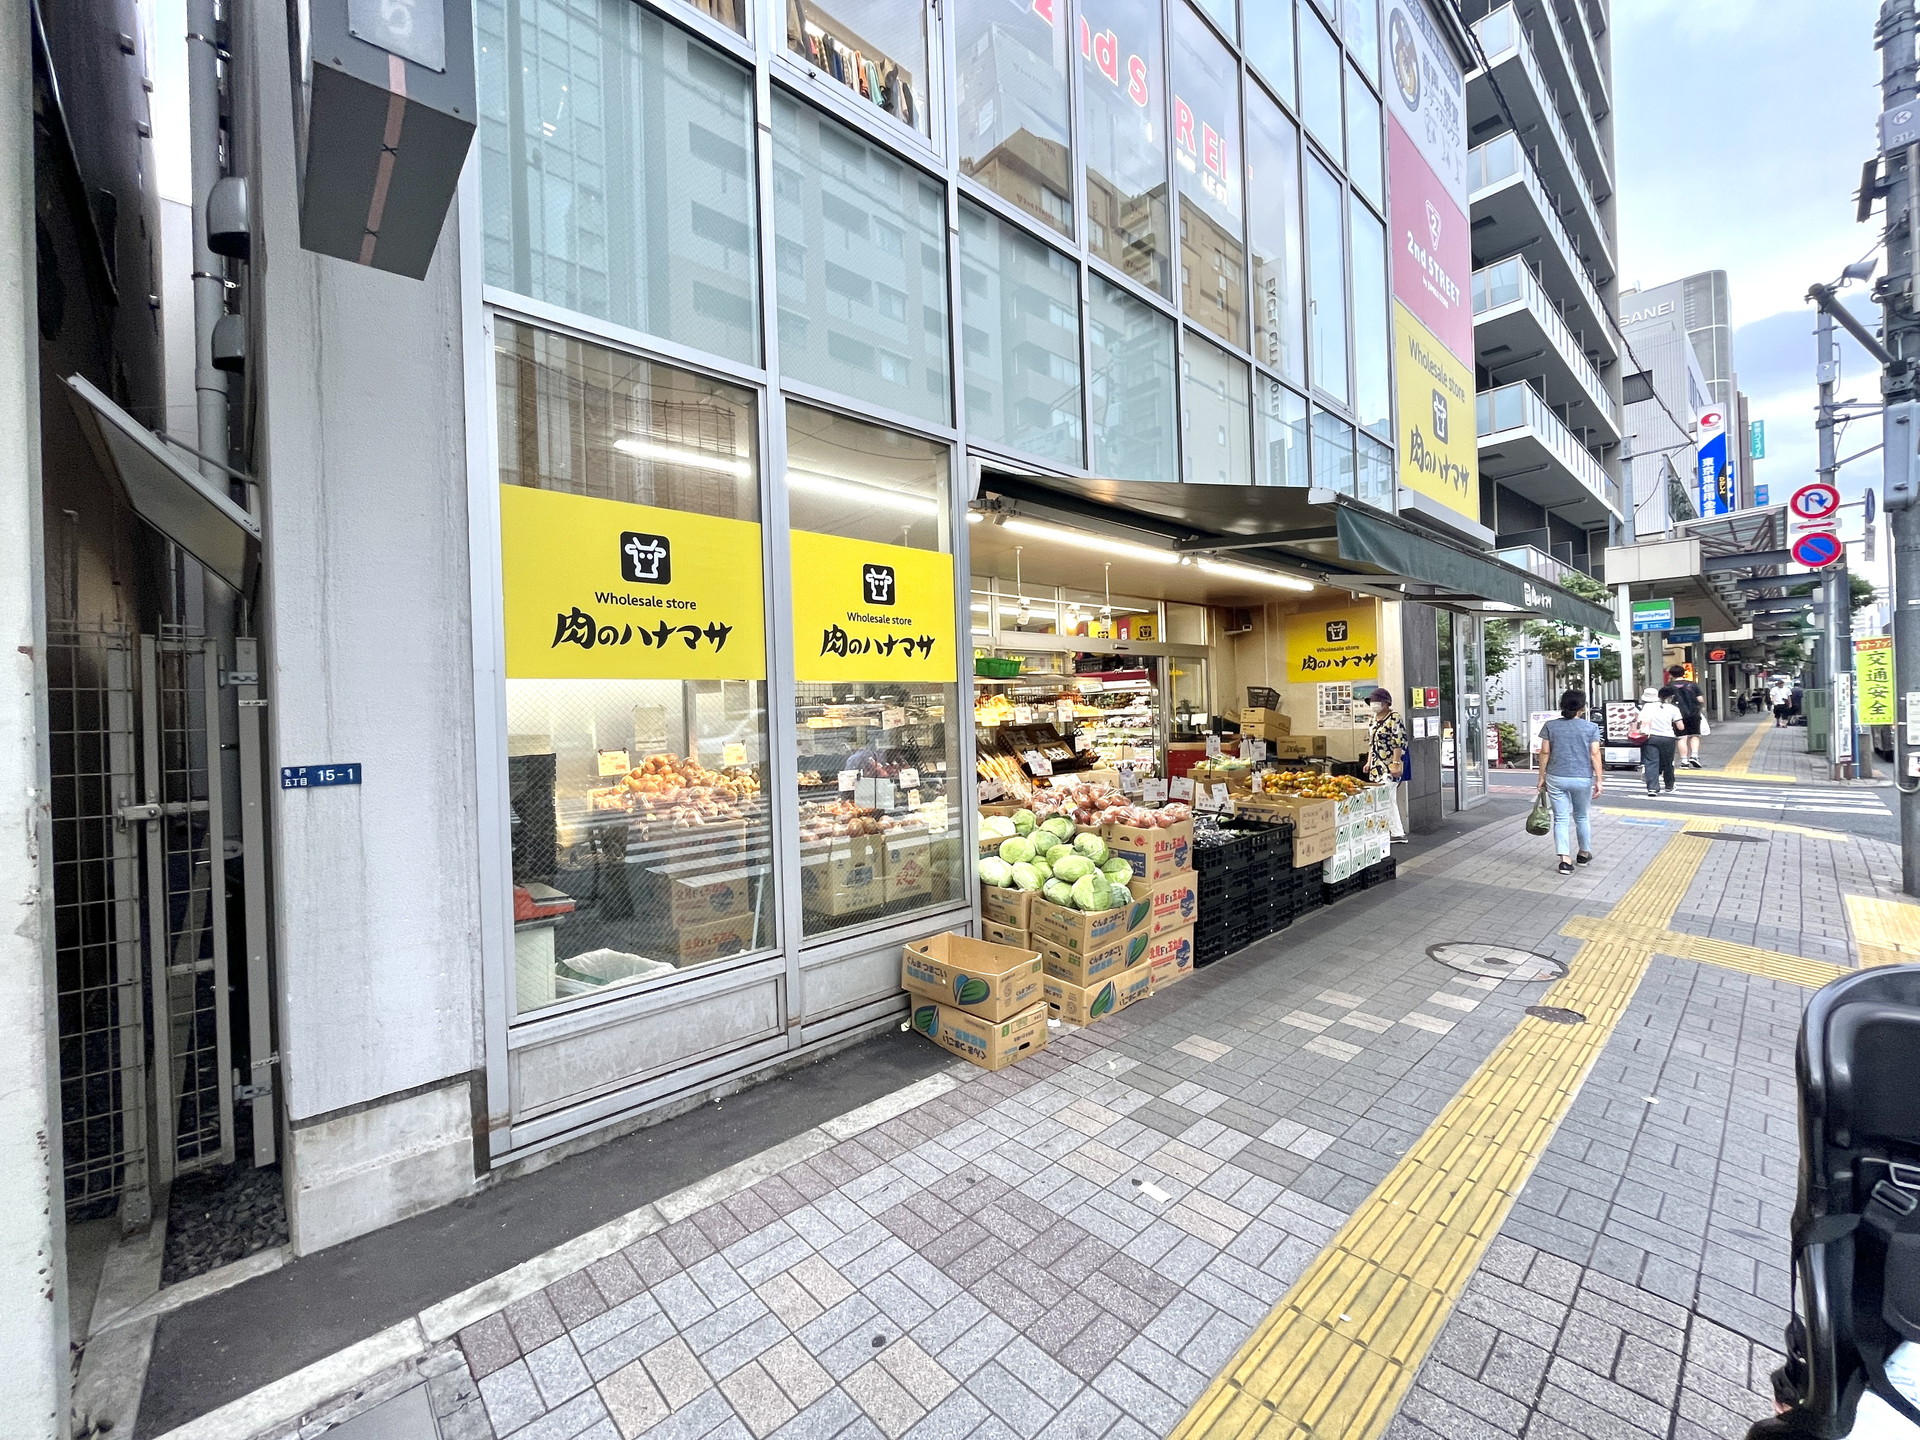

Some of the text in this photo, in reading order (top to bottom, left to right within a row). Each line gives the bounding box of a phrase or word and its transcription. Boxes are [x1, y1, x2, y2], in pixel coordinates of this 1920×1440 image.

[1407, 230, 1461, 307] 2nd STREET
[1619, 300, 1675, 328] SANEI
[1408, 335, 1466, 404] Wholesale store
[1408, 424, 1470, 499] 肉のハナマサ
[595, 591, 697, 611] Wholesale store
[1634, 611, 1669, 619] FamilyMart
[551, 606, 733, 654] 肉のハナマサ
[846, 611, 913, 626] Wholesale store
[819, 623, 936, 660] 肉のハナマサ
[1301, 652, 1378, 671] 肉のハナマサ
[1865, 650, 1890, 715] 交通安全
[317, 768, 354, 781] 15-1
